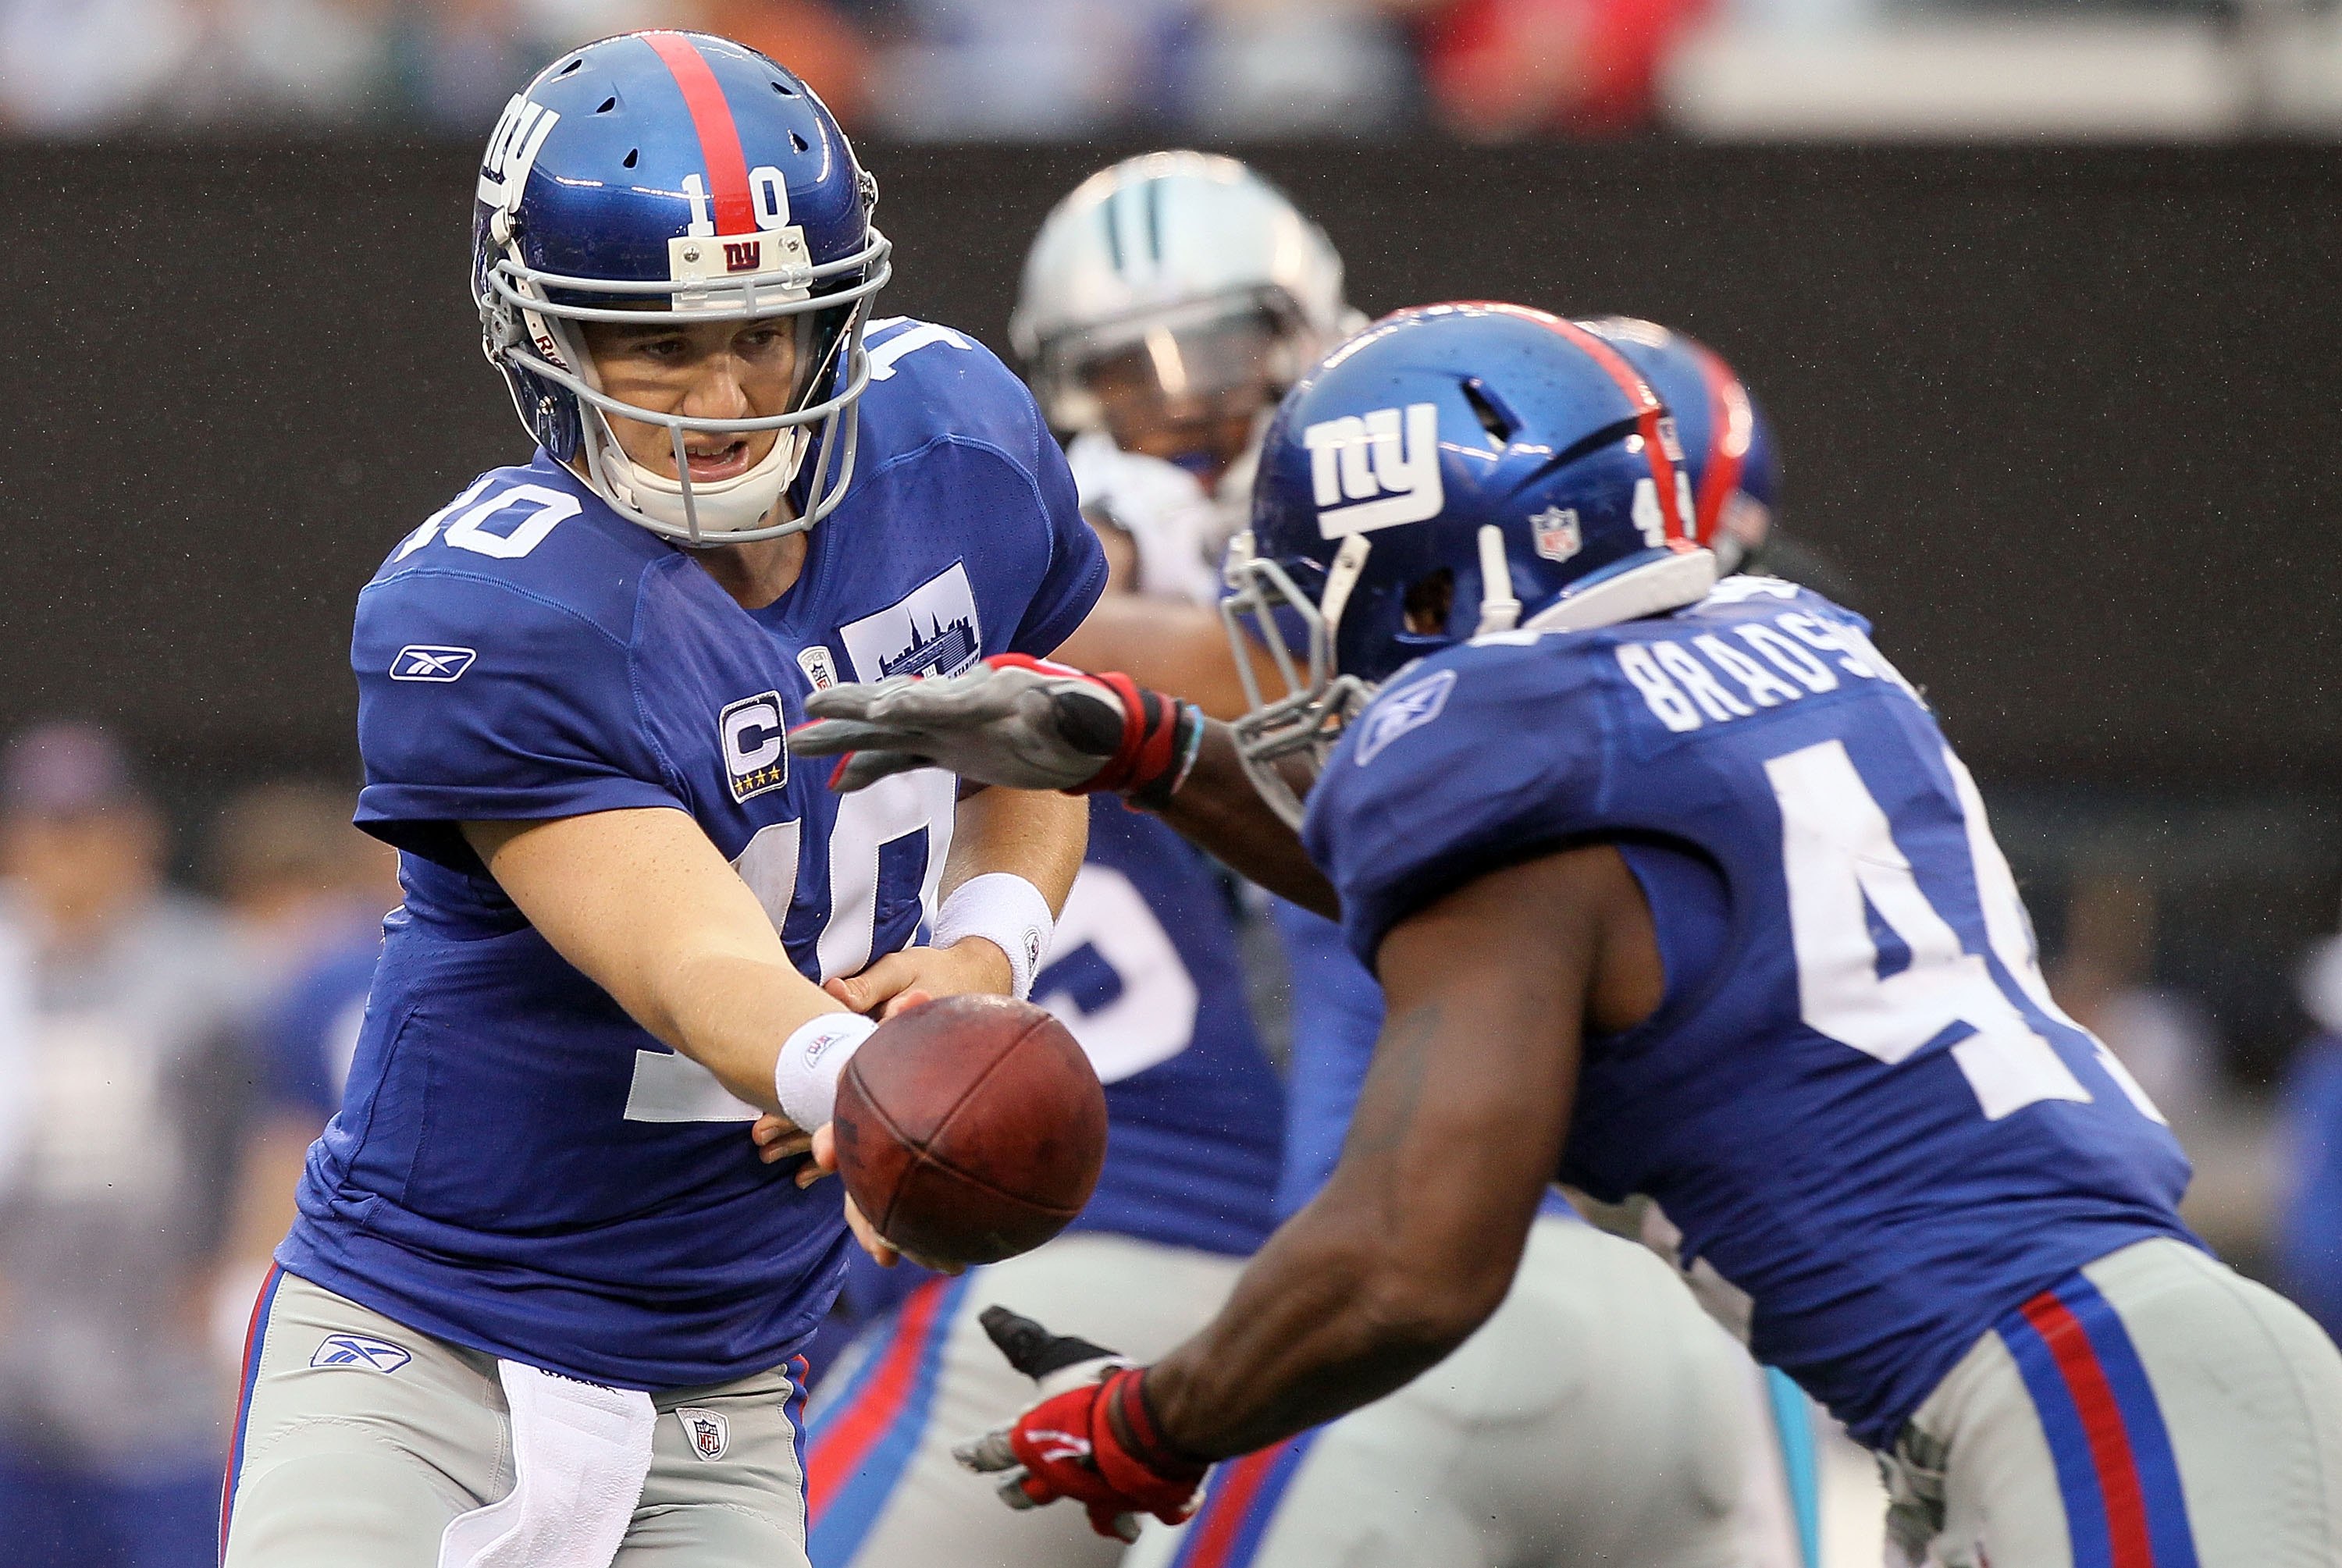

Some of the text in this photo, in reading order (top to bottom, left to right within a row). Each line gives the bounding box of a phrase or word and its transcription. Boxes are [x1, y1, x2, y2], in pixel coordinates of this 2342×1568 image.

[393, 478, 583, 560] 10
[1304, 402, 1445, 540] ny
[1615, 613, 1905, 732] BRADS
[725, 704, 781, 777] C
